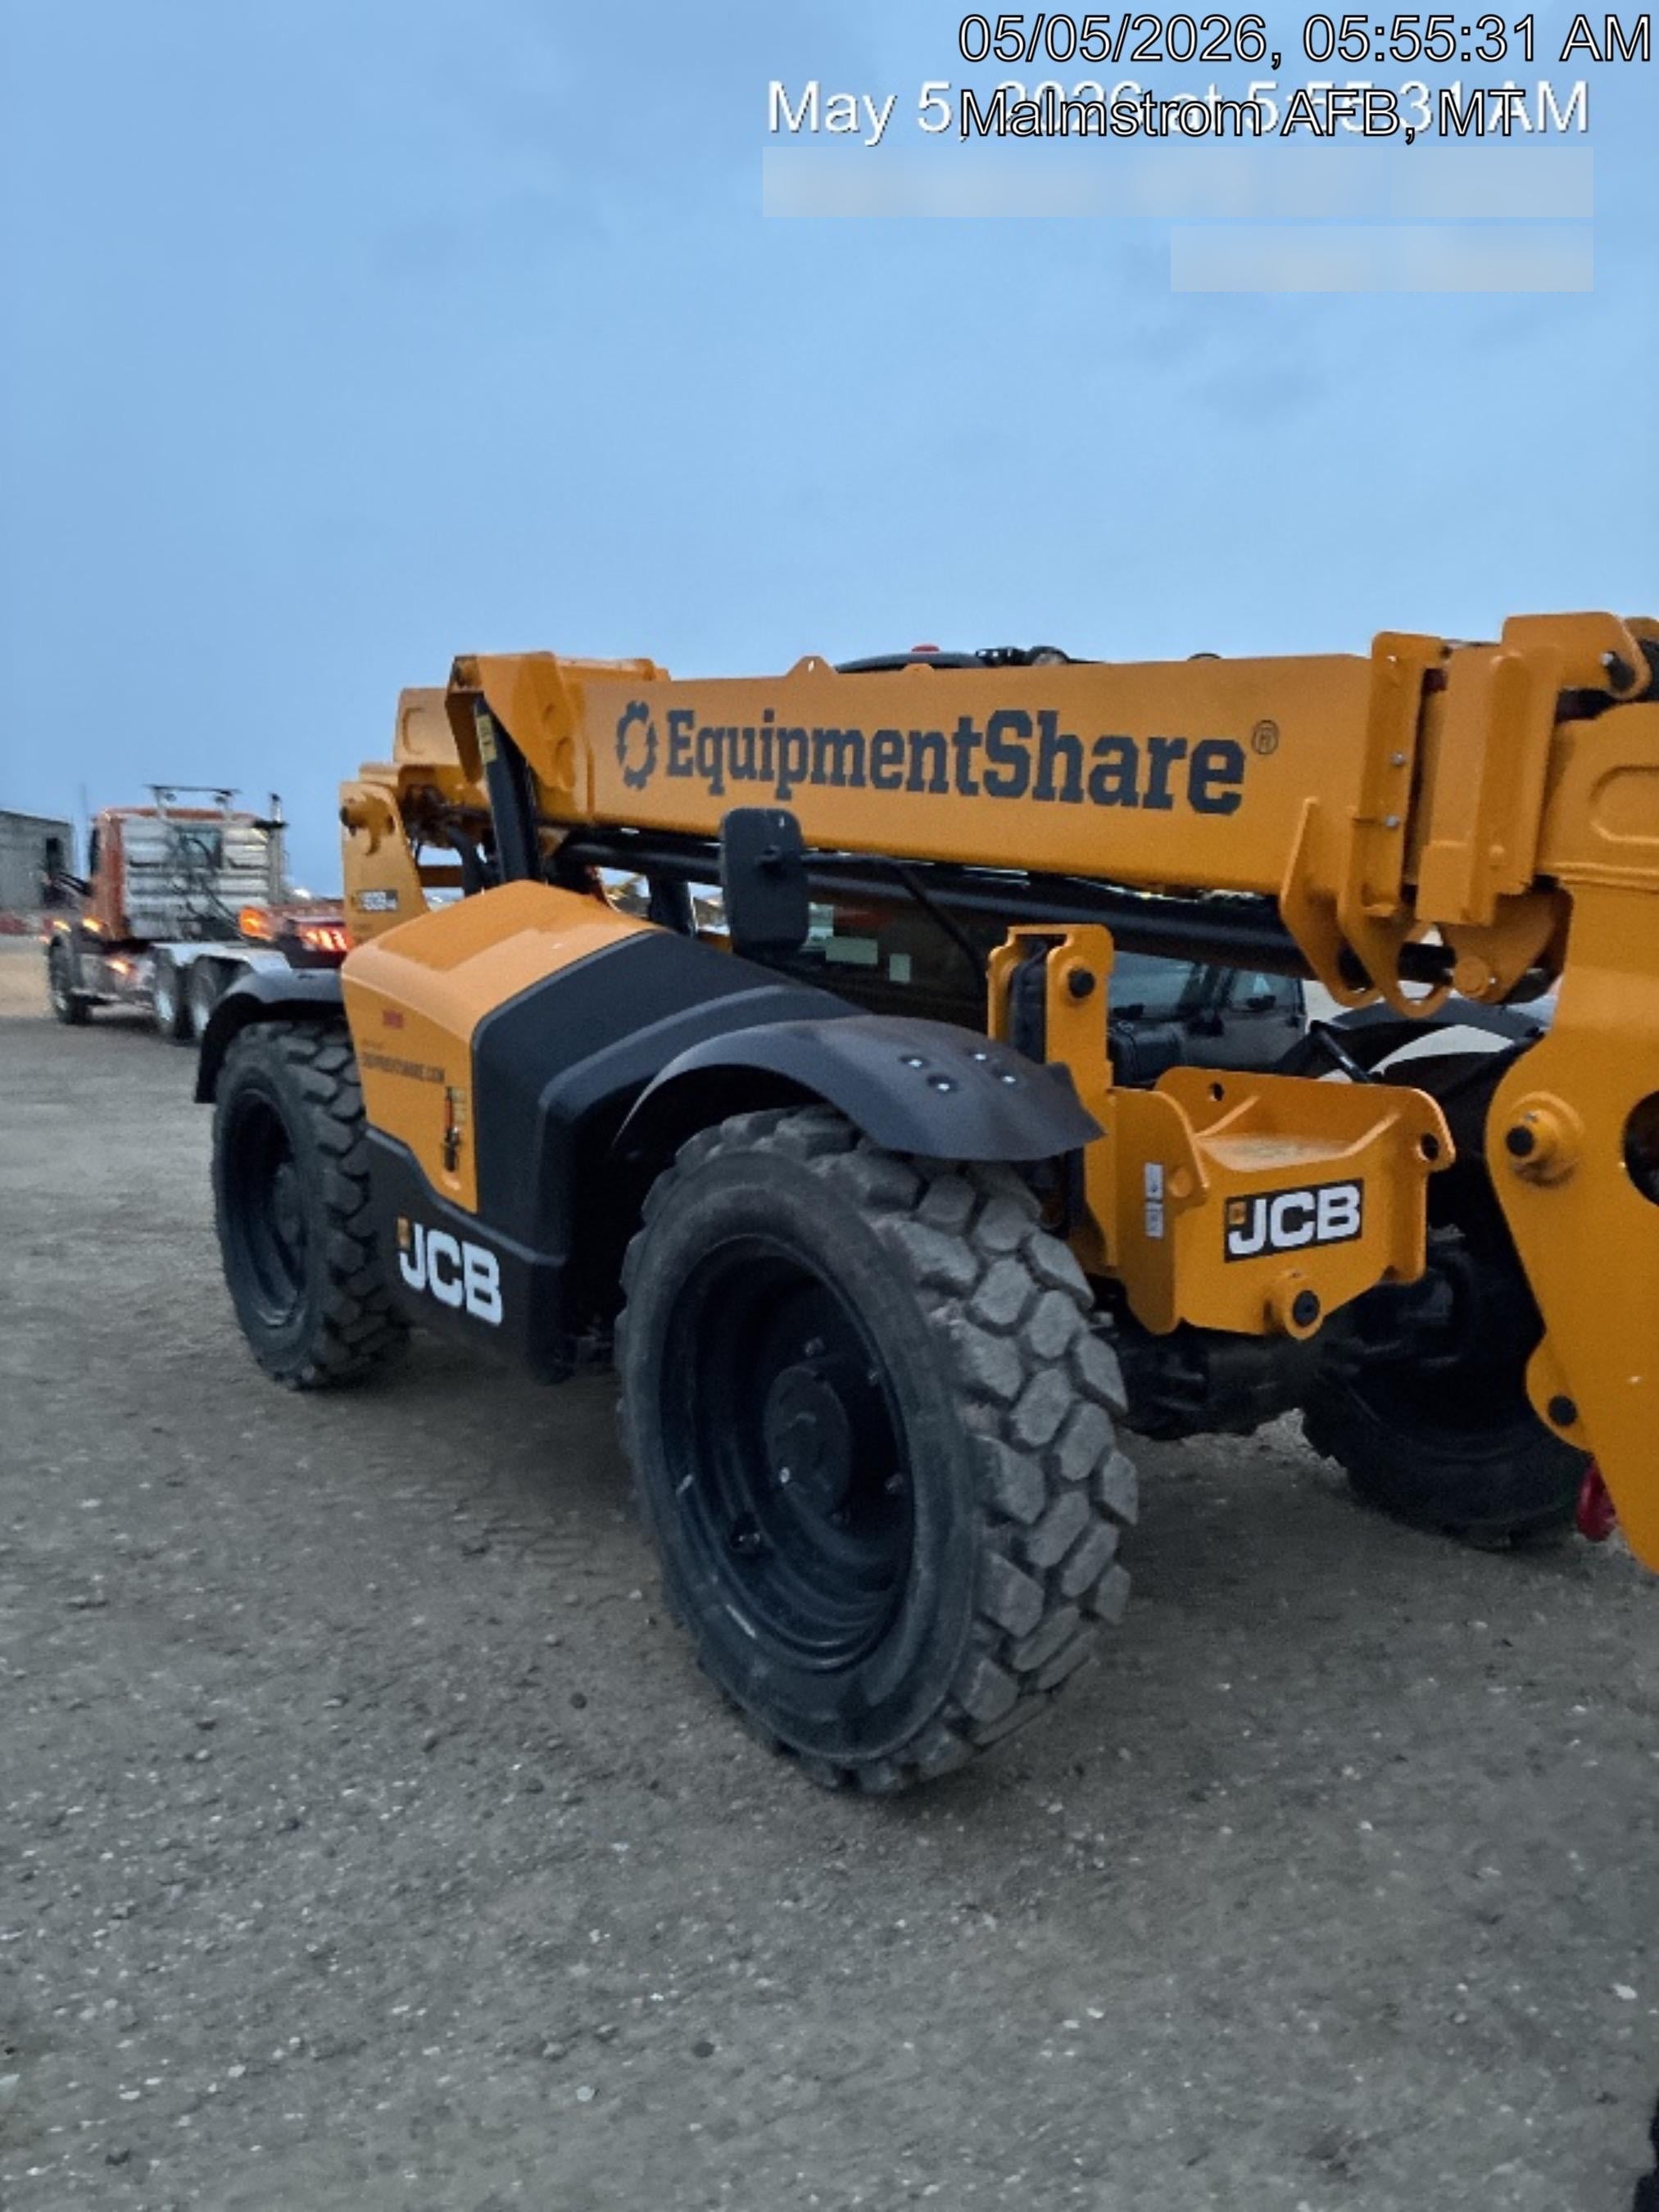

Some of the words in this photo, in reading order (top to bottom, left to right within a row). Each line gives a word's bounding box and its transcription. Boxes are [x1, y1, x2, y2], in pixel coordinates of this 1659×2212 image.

[665, 709, 1247, 817] EquipmentShare
[1228, 1185, 1361, 1254] JCB
[399, 1222, 503, 1325] JCB
